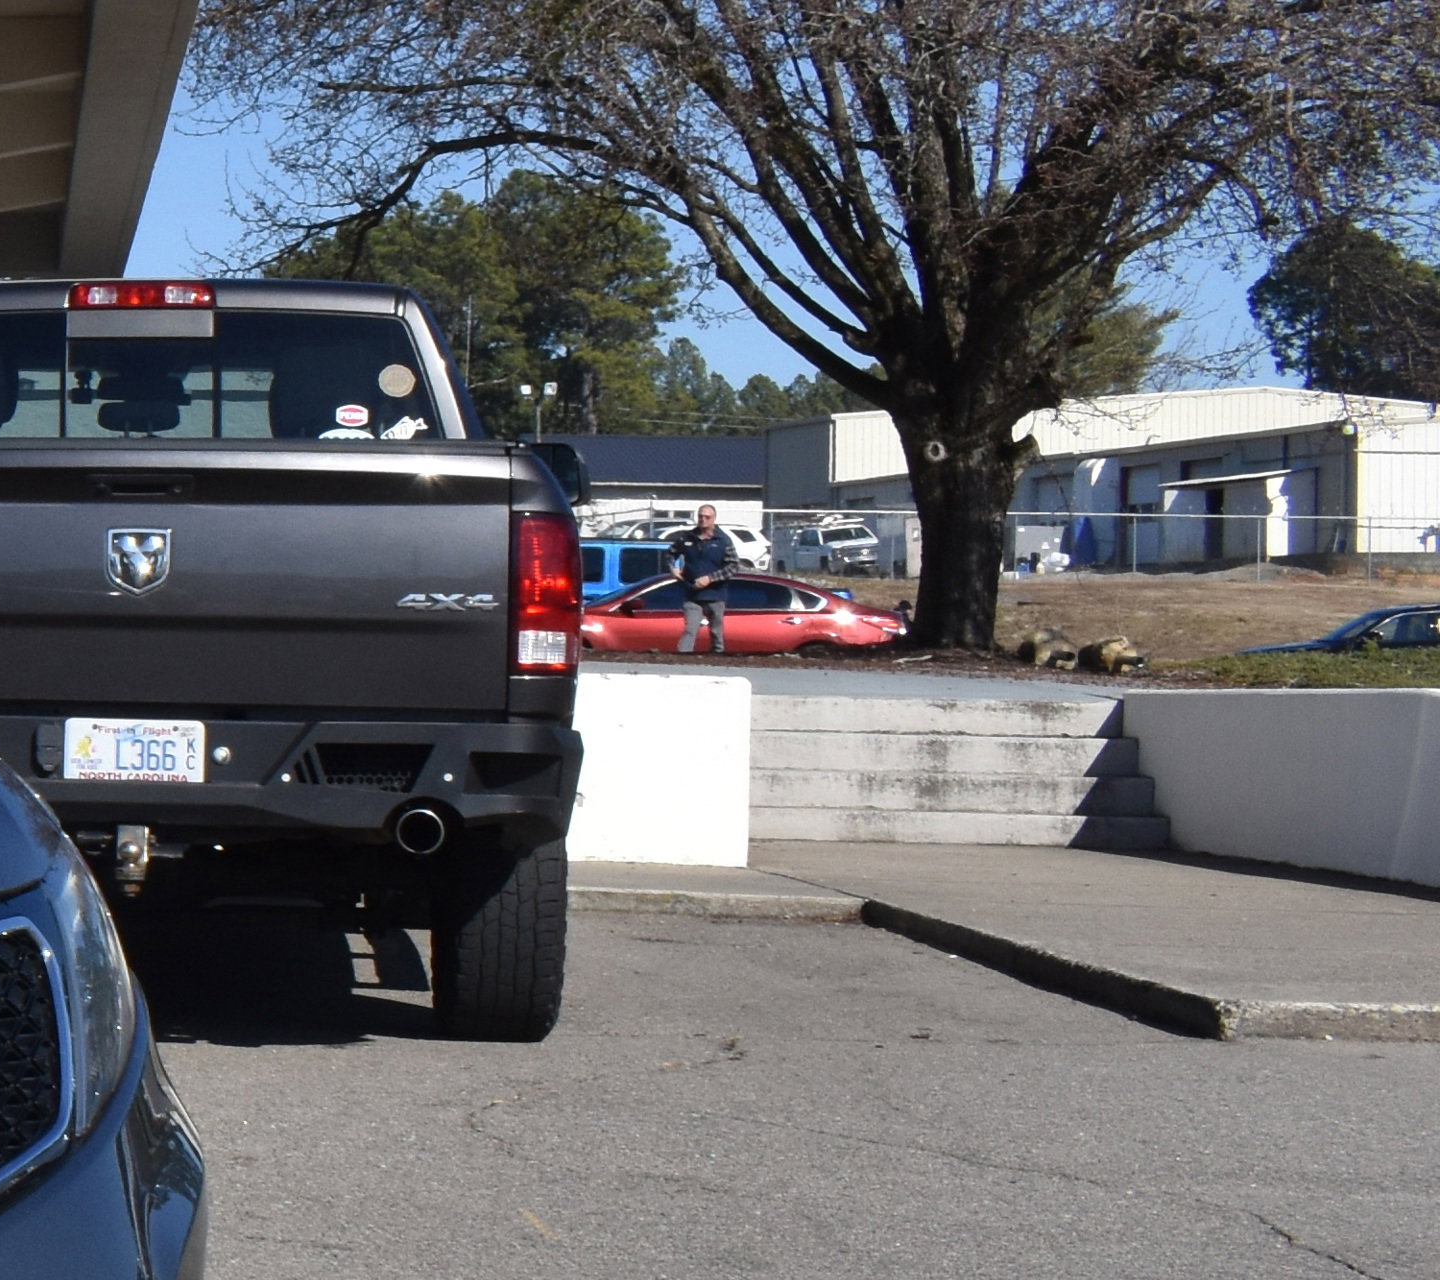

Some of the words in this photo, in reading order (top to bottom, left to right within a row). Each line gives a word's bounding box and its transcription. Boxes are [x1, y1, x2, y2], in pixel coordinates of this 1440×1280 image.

[395, 593, 499, 612] 4X4
[142, 726, 172, 737] Flight
[116, 739, 176, 771] L366
[79, 771, 122, 780] NORTH
[126, 772, 188, 782] CAROLINA
